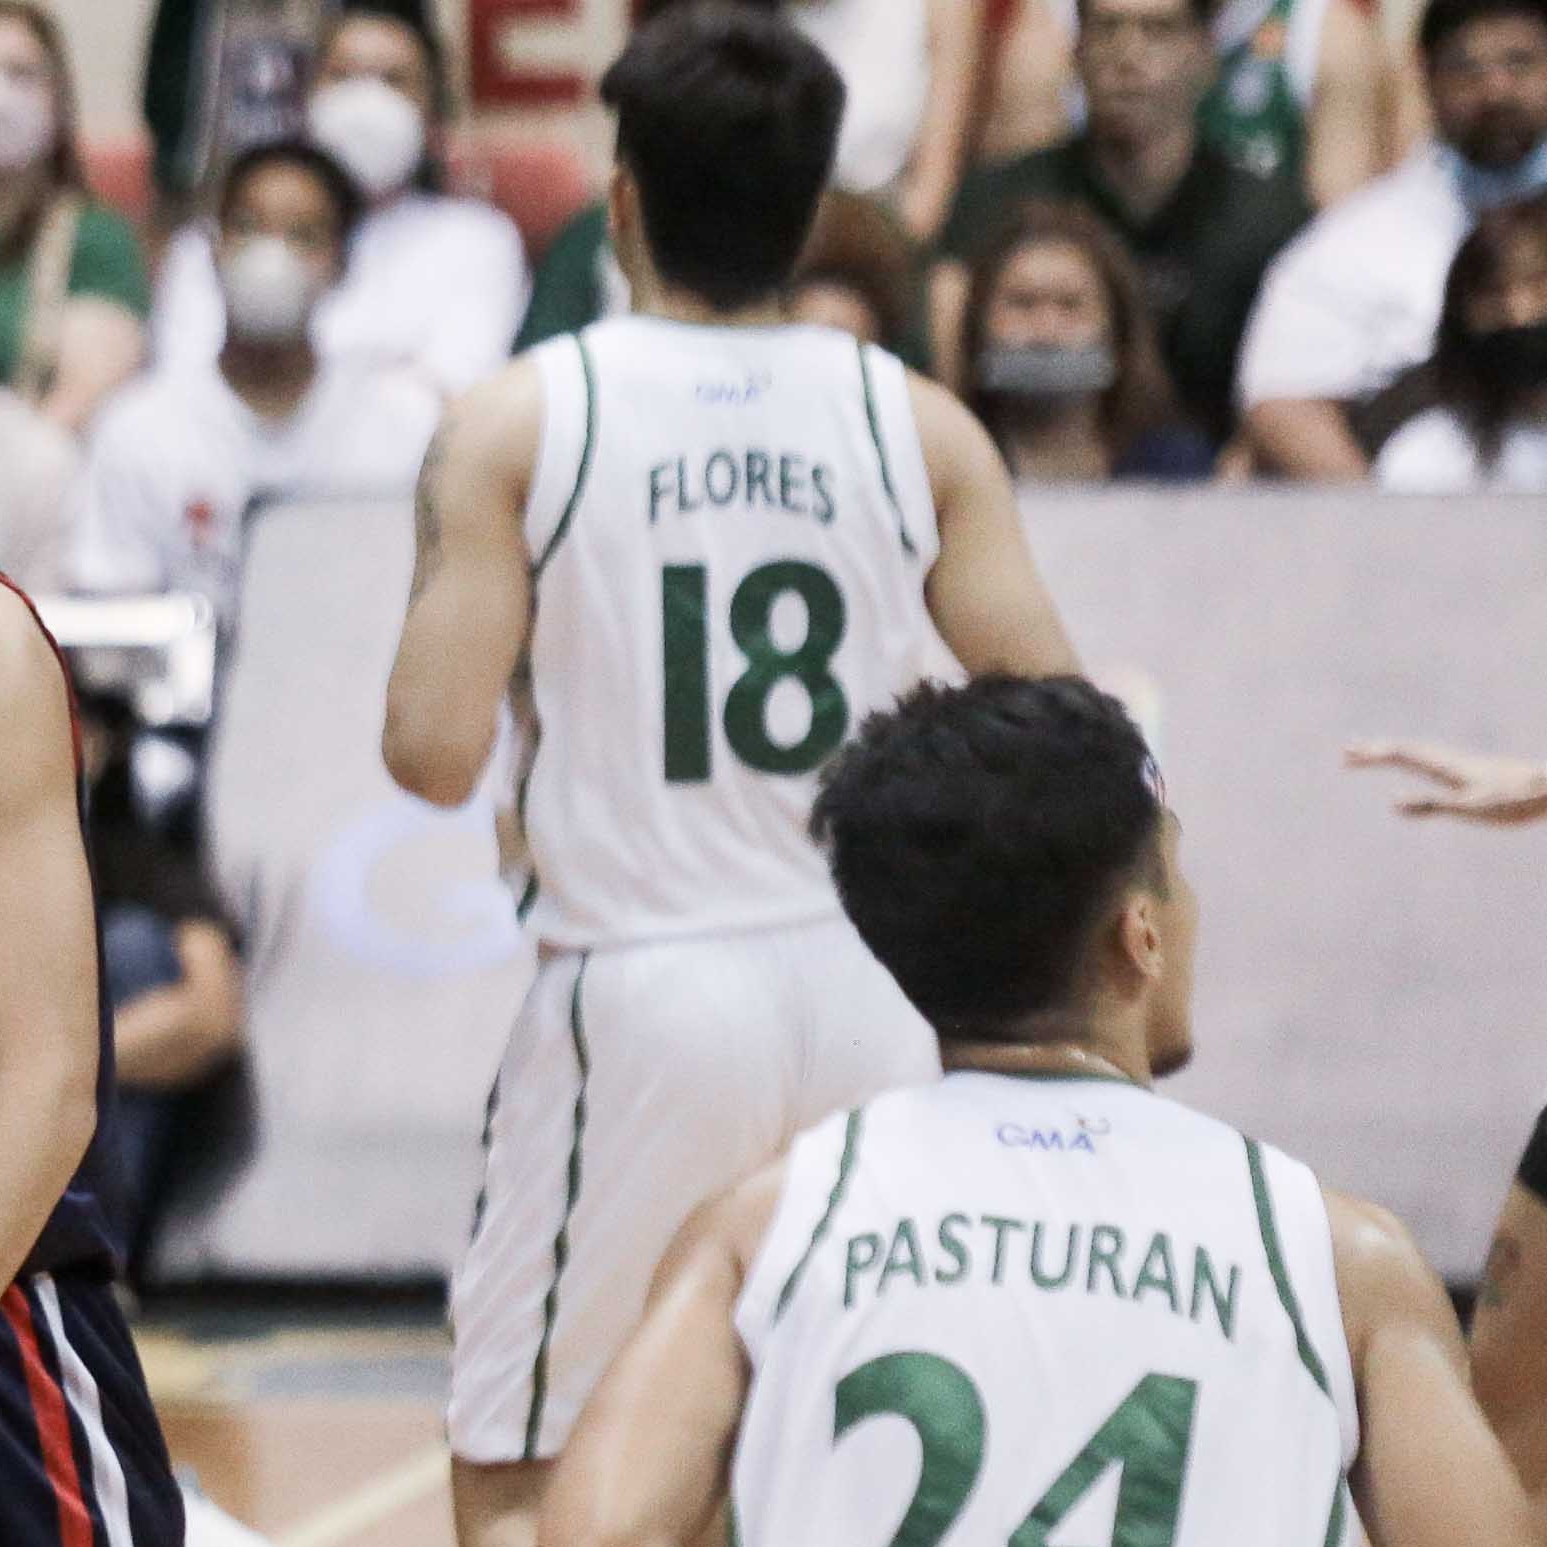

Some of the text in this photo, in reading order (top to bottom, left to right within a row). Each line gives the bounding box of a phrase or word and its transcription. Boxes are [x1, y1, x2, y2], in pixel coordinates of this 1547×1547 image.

[649, 448, 836, 527] FLORES
[662, 558, 849, 783] 18
[841, 1213, 1243, 1343] PASTURAN
